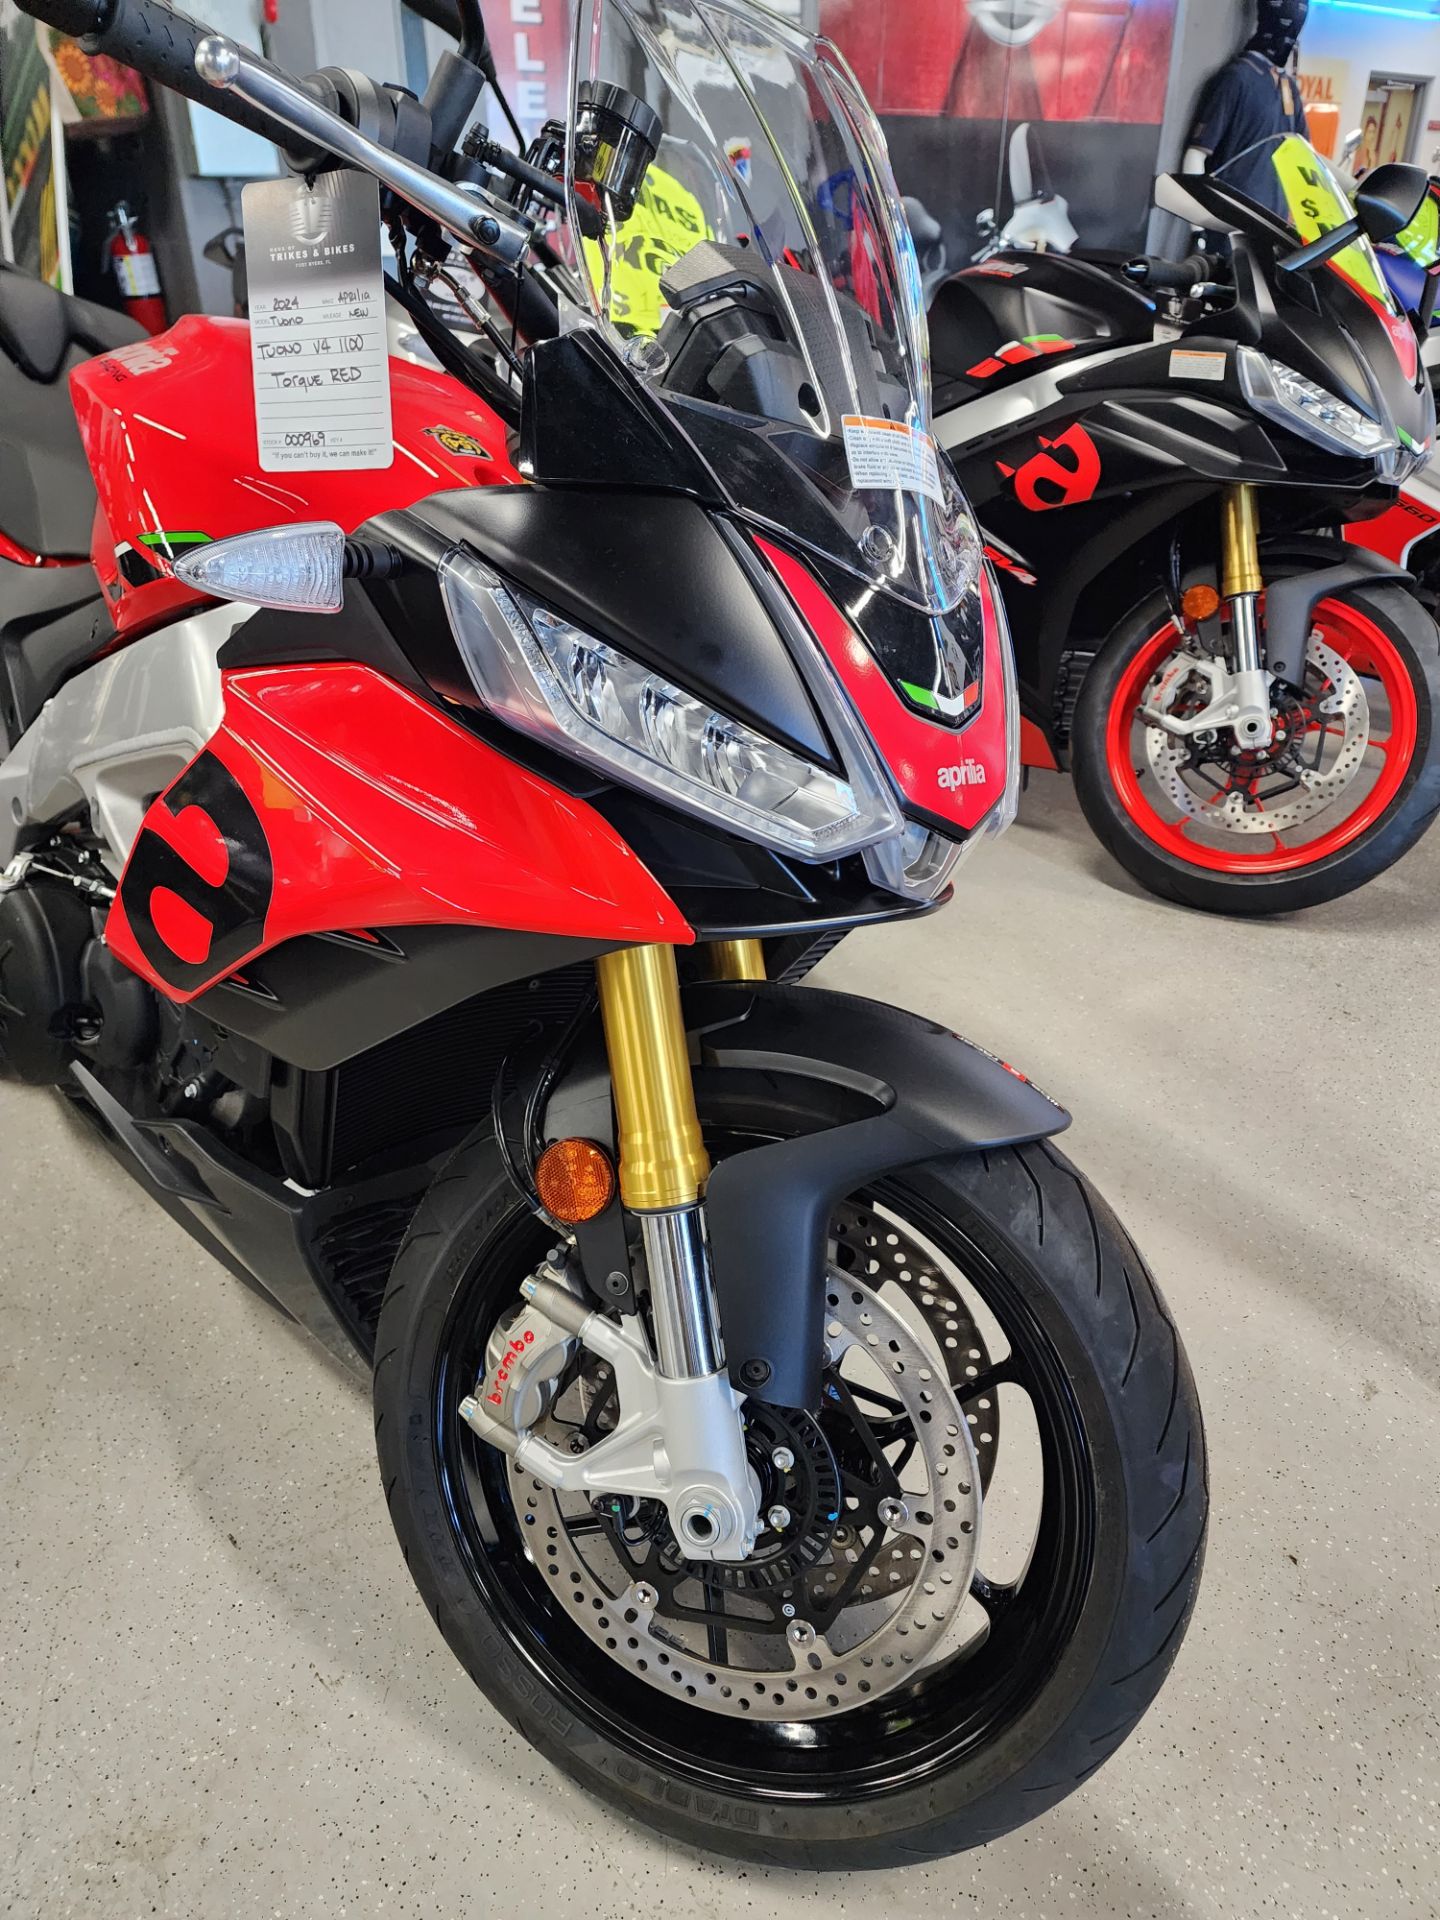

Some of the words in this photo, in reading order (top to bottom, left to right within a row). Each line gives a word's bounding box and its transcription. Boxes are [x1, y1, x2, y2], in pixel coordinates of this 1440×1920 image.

[1297, 75, 1333, 99] OYAL
[270, 250, 308, 262] TRIKES
[313, 249, 320, 258] &
[324, 243, 355, 256] BIKES
[273, 295, 299, 311] 2024
[313, 337, 331, 355] V4
[339, 333, 364, 353] 1100
[330, 366, 362, 383] RED
[285, 431, 325, 447] 000969
[937, 758, 986, 792] aprilia
[486, 1330, 535, 1406] brembo
